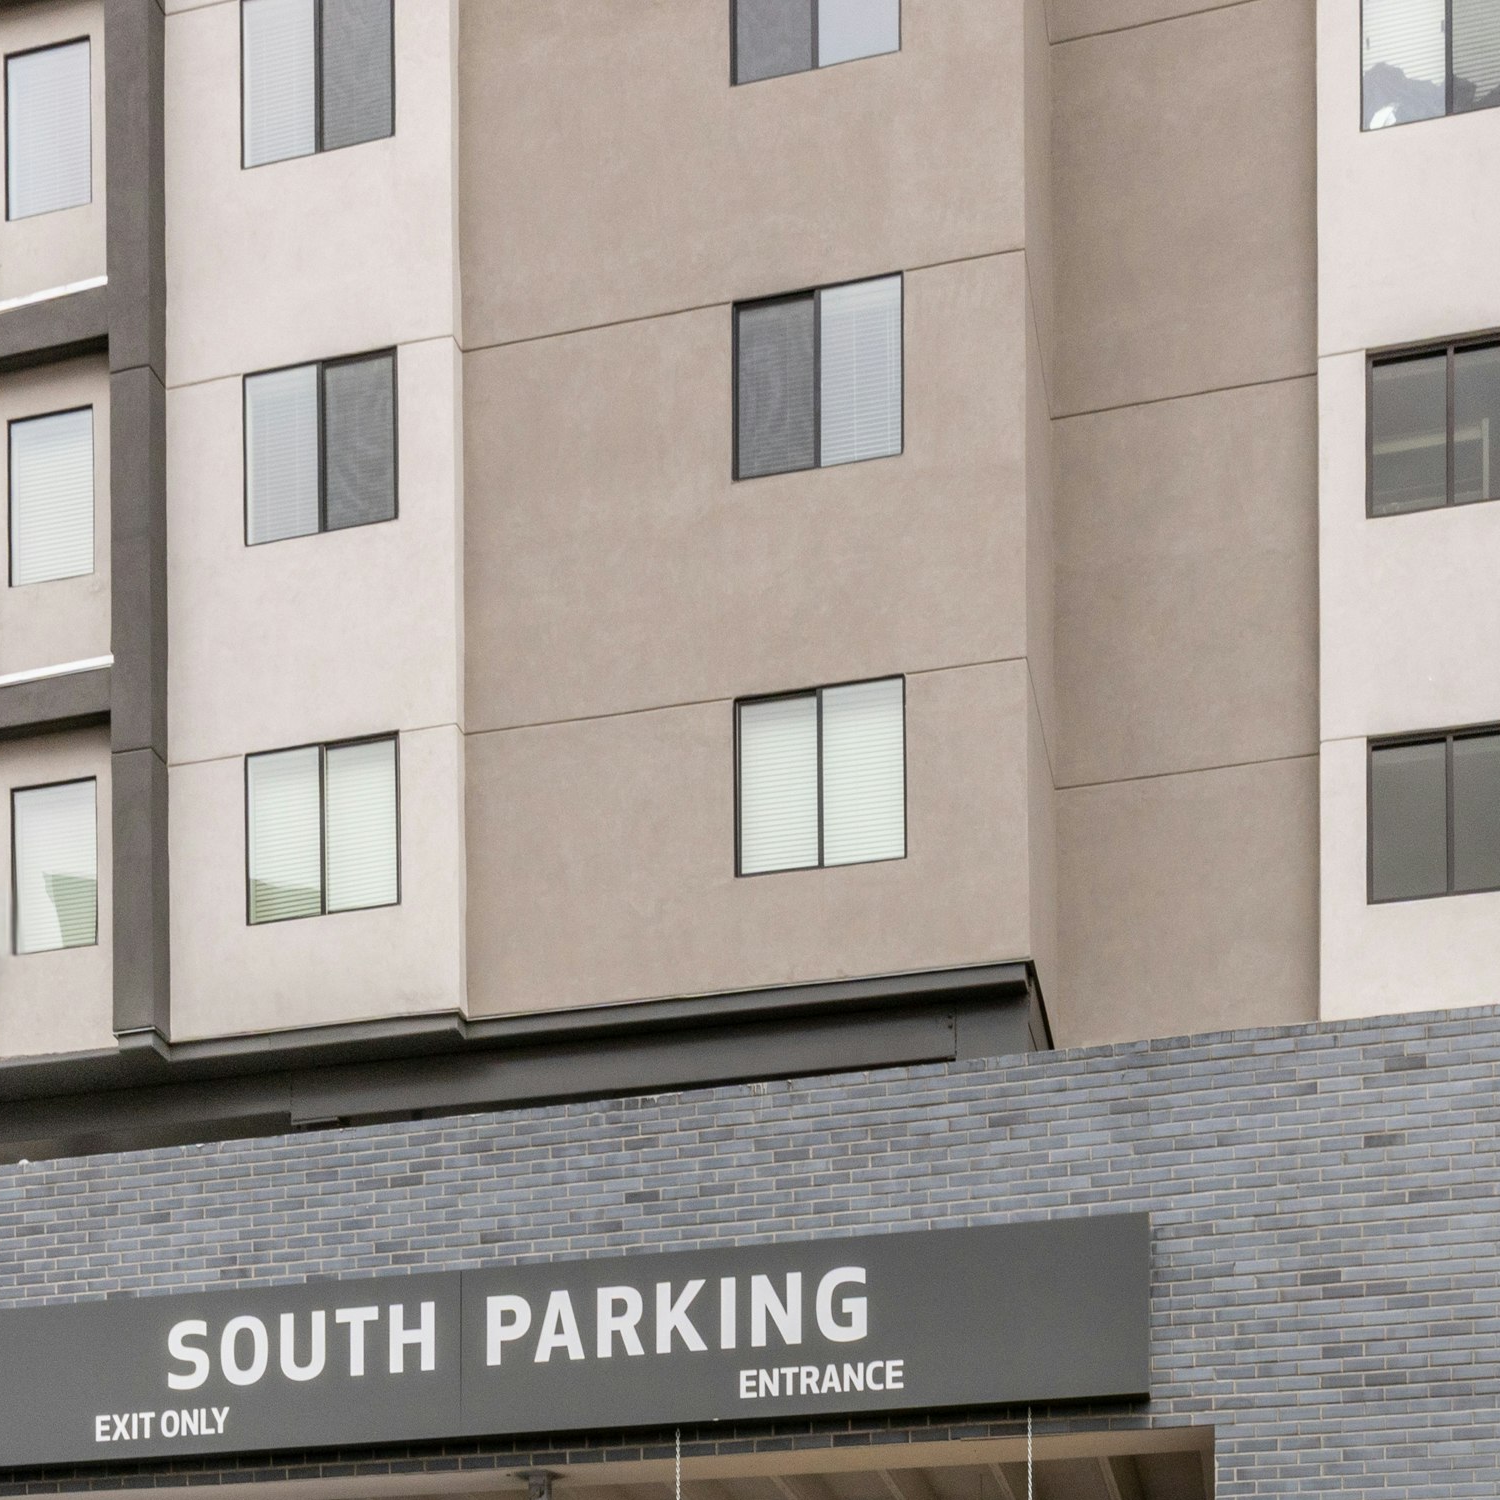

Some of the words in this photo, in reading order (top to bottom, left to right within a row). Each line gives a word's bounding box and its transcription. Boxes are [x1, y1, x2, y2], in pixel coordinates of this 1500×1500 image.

[167, 1301, 436, 1391] SOUTH
[486, 1266, 868, 1367] PARKING
[739, 1359, 904, 1399] ENTRANCE
[95, 1411, 156, 1442] EXIT
[160, 1406, 230, 1438] ONLY
